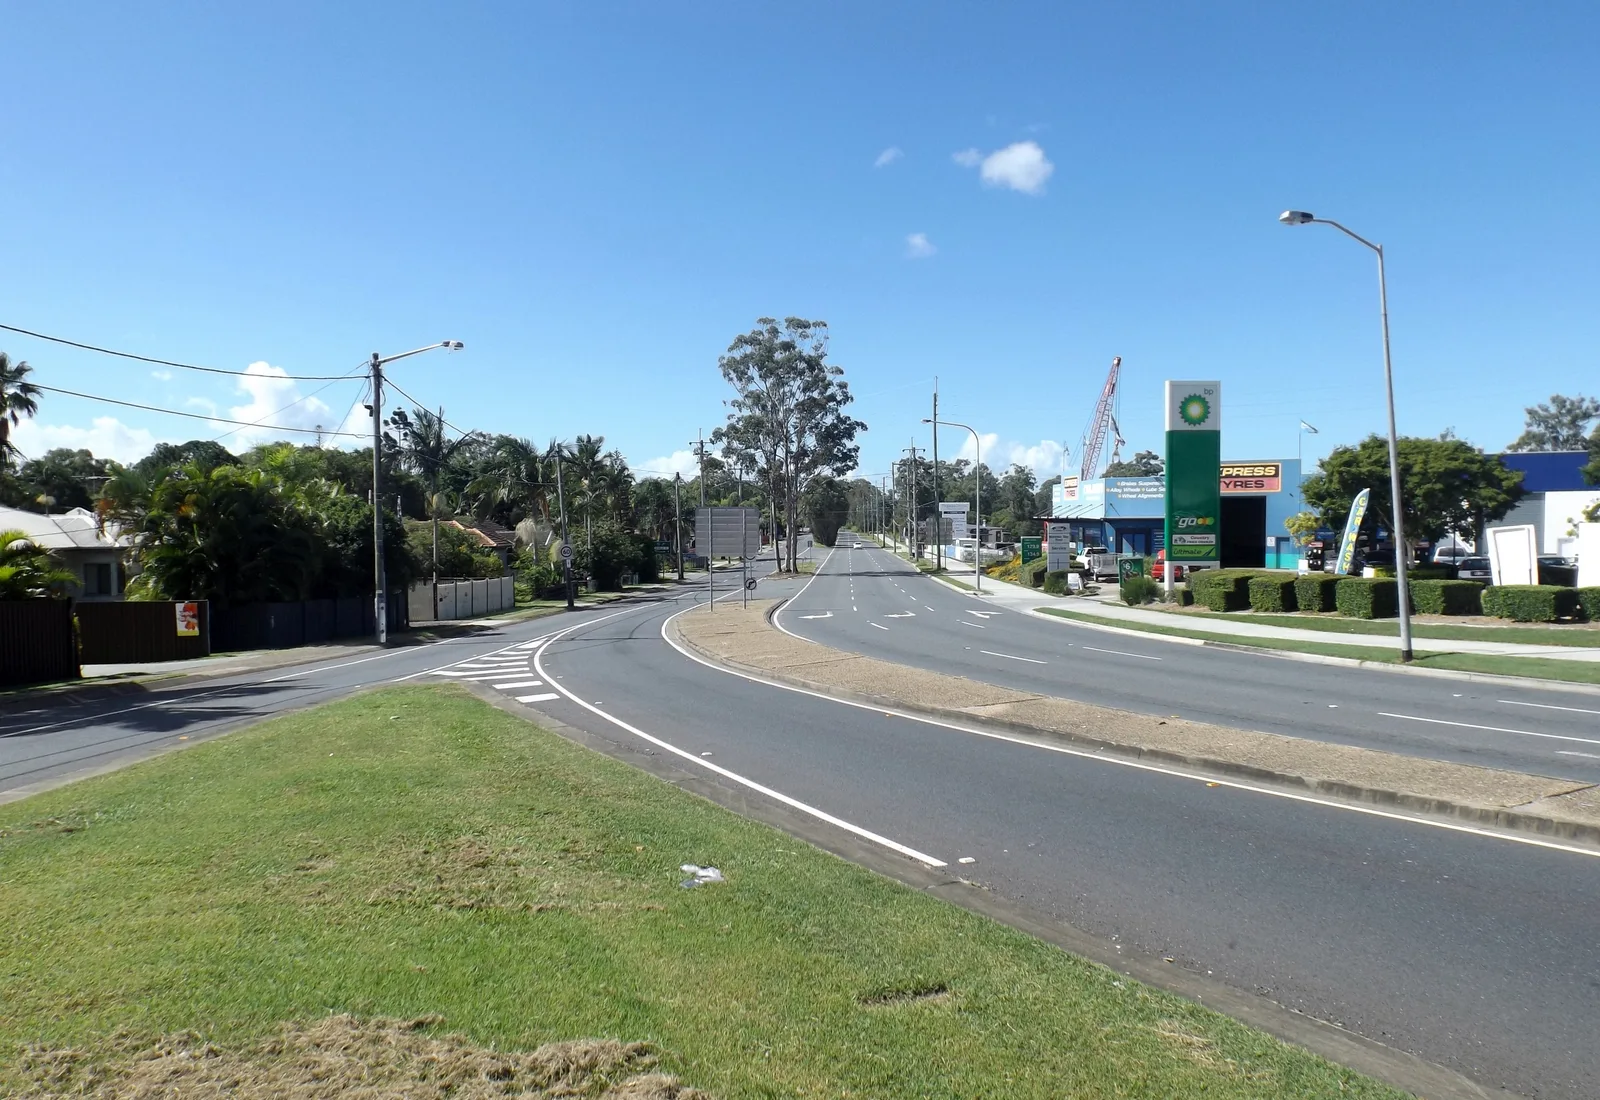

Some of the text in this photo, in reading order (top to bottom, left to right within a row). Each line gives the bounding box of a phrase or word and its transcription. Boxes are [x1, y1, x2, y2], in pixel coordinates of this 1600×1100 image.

[1204, 388, 1214, 396] bp
[1220, 480, 1265, 488] YRES
[1343, 496, 1366, 571] CAR WASH
